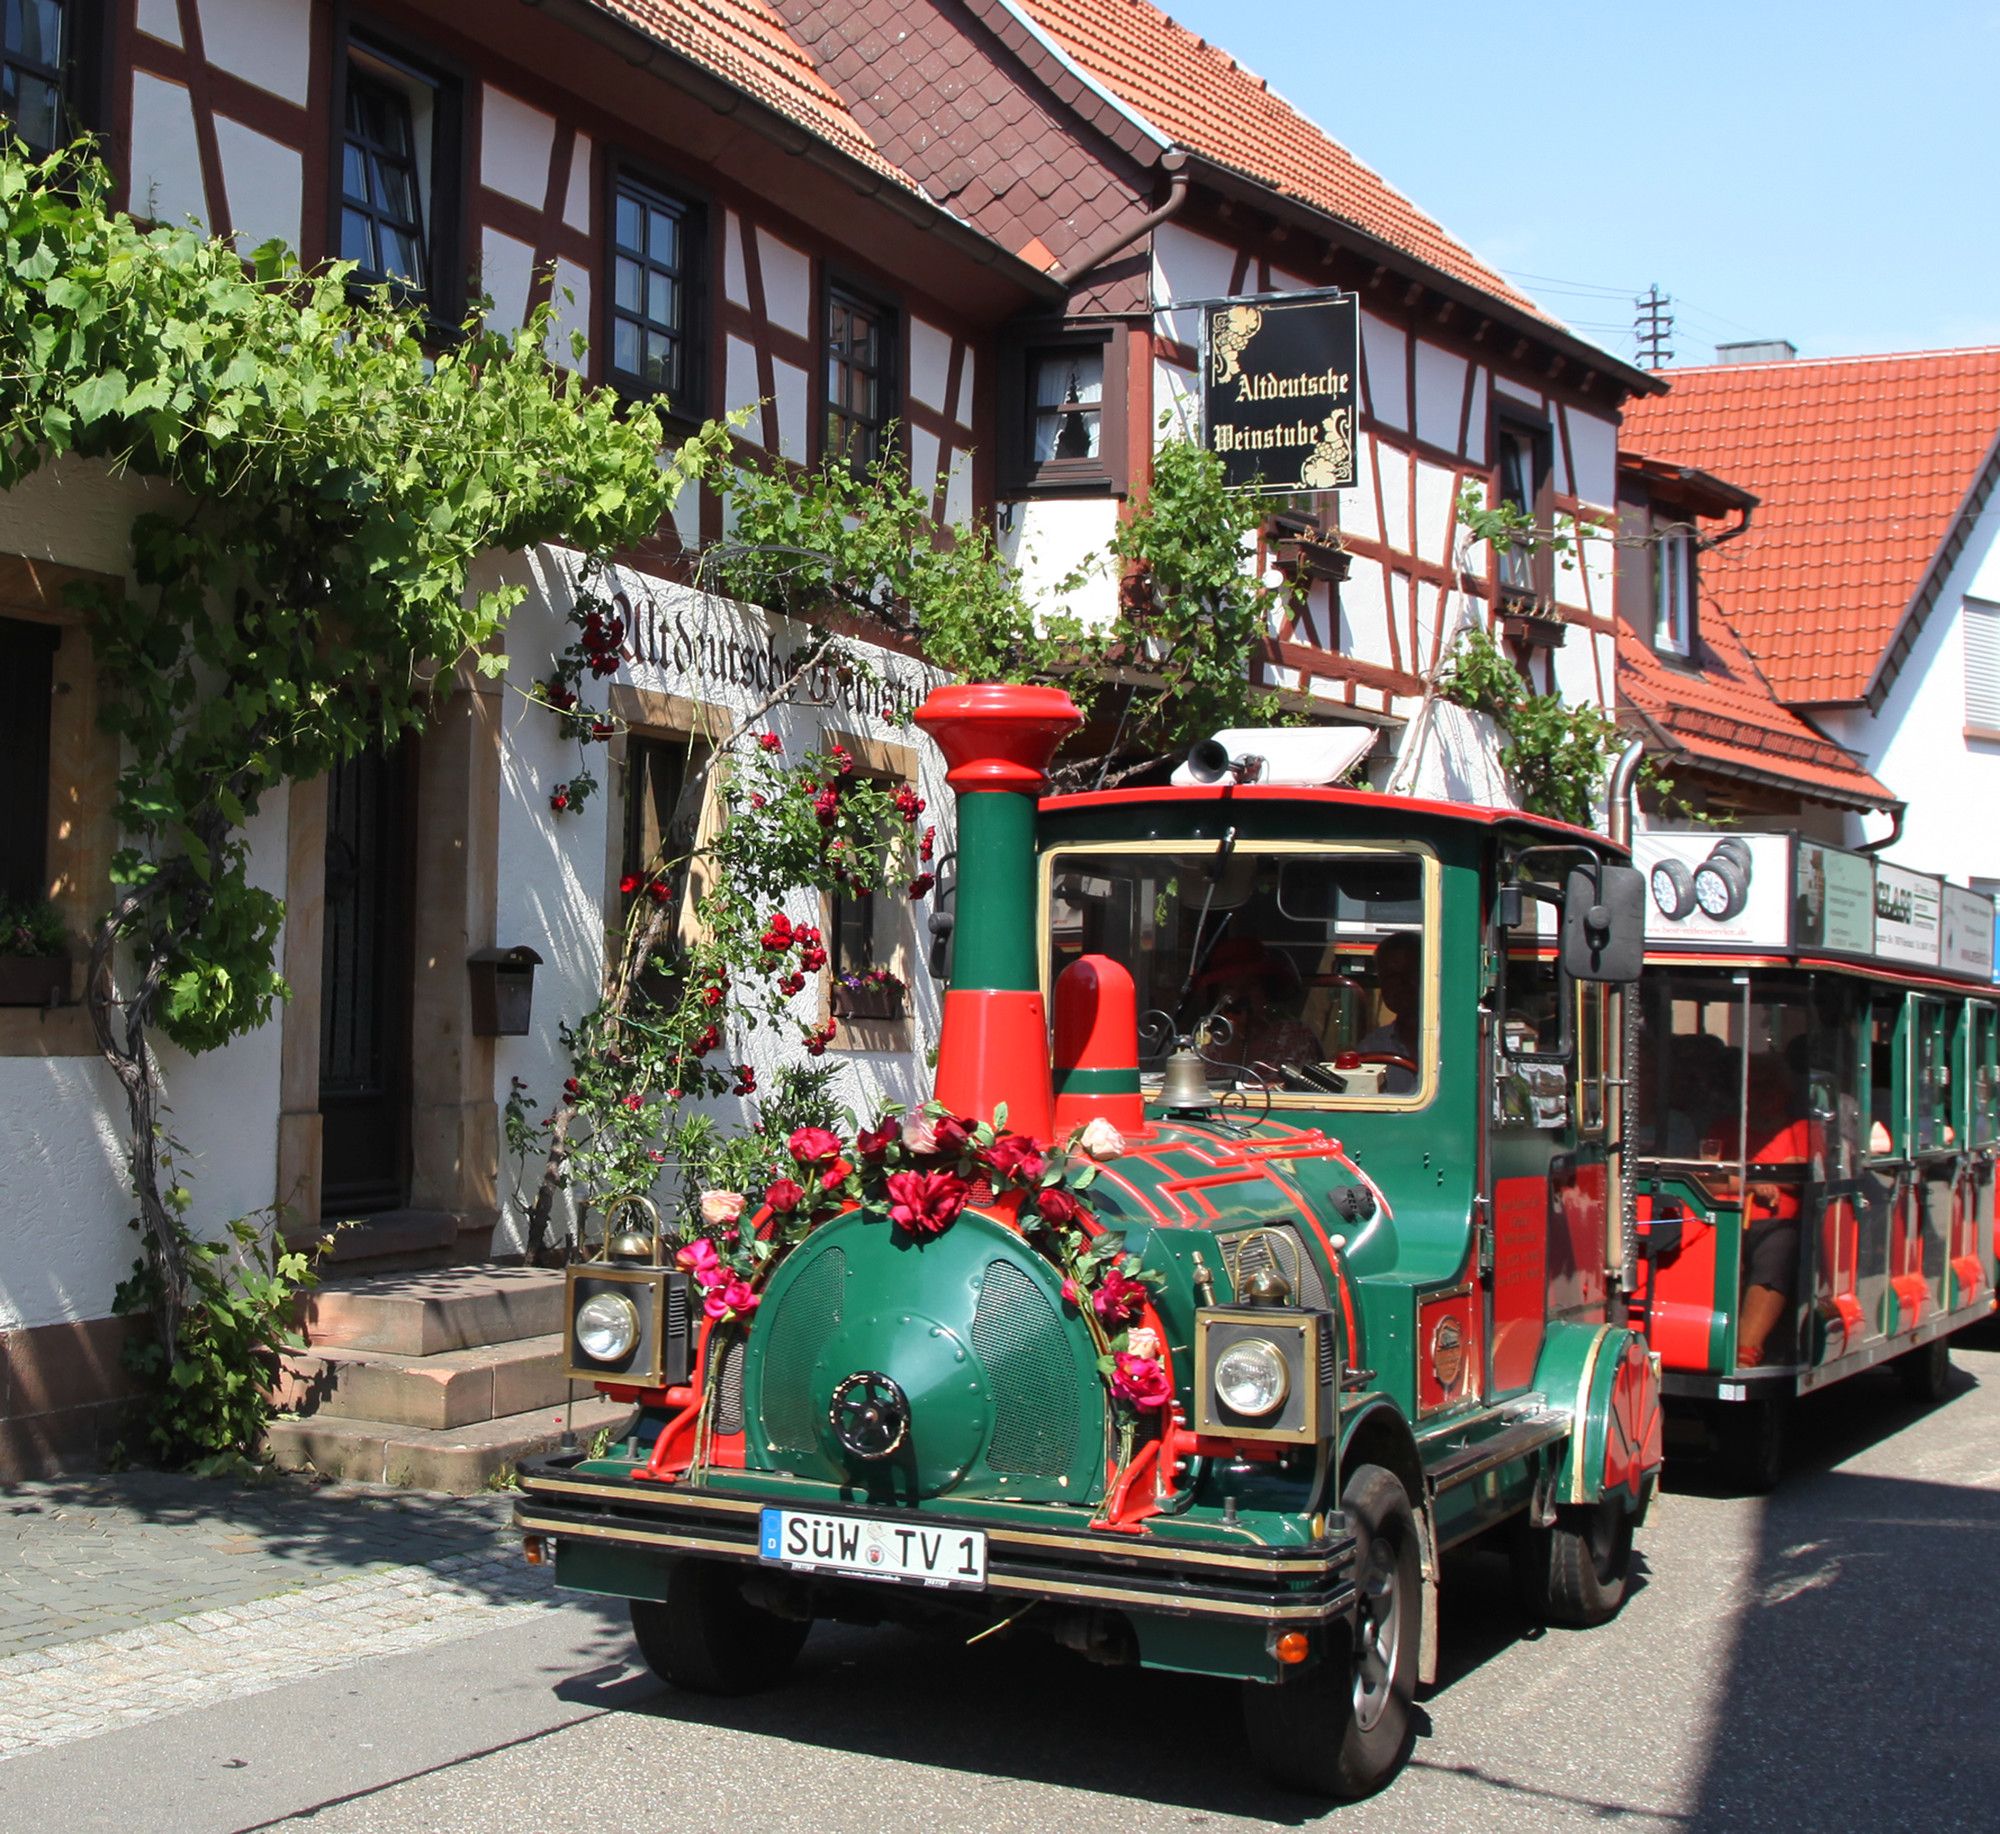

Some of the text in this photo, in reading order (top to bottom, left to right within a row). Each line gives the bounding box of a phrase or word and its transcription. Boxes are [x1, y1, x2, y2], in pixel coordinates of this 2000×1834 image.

[1235, 367, 1349, 402] Altdeutsche
[1213, 419, 1319, 453] Weinstube
[767, 1538, 777, 1549] D
[894, 1529, 942, 1571] TV
[958, 1536, 979, 1576] 1
